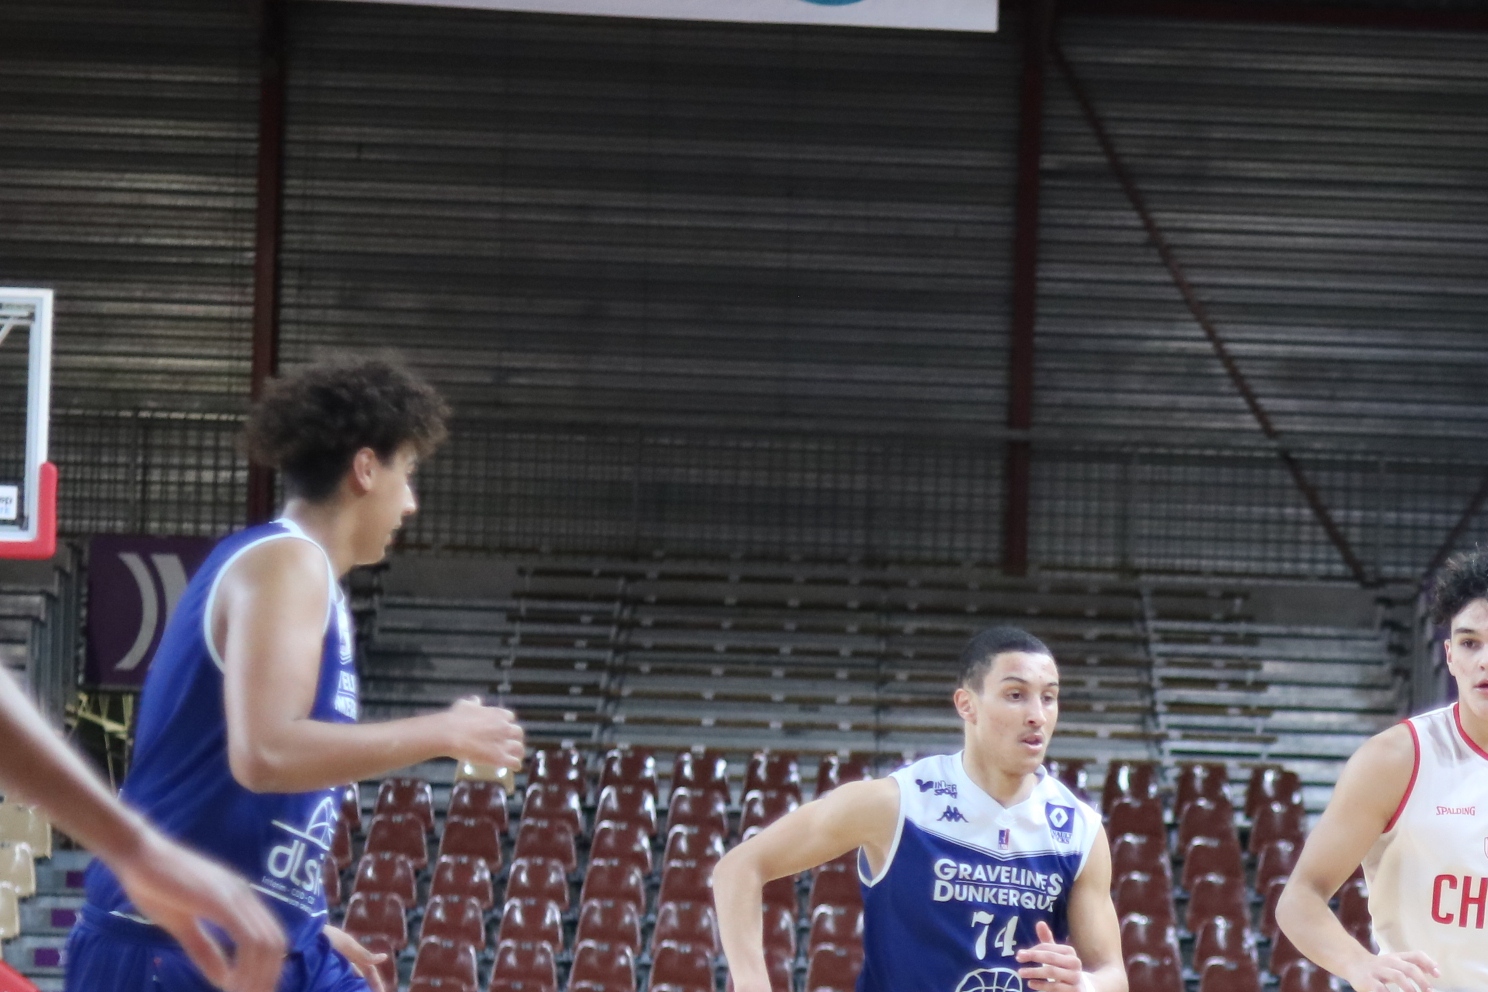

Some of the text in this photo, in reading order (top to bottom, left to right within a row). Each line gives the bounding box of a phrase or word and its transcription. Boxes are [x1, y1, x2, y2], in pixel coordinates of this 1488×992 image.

[1436, 805, 1476, 816] SPALDING
[933, 858, 1064, 896] GRAVELINES
[933, 880, 1058, 912] DUNKERQUE
[971, 911, 1018, 960] 74
